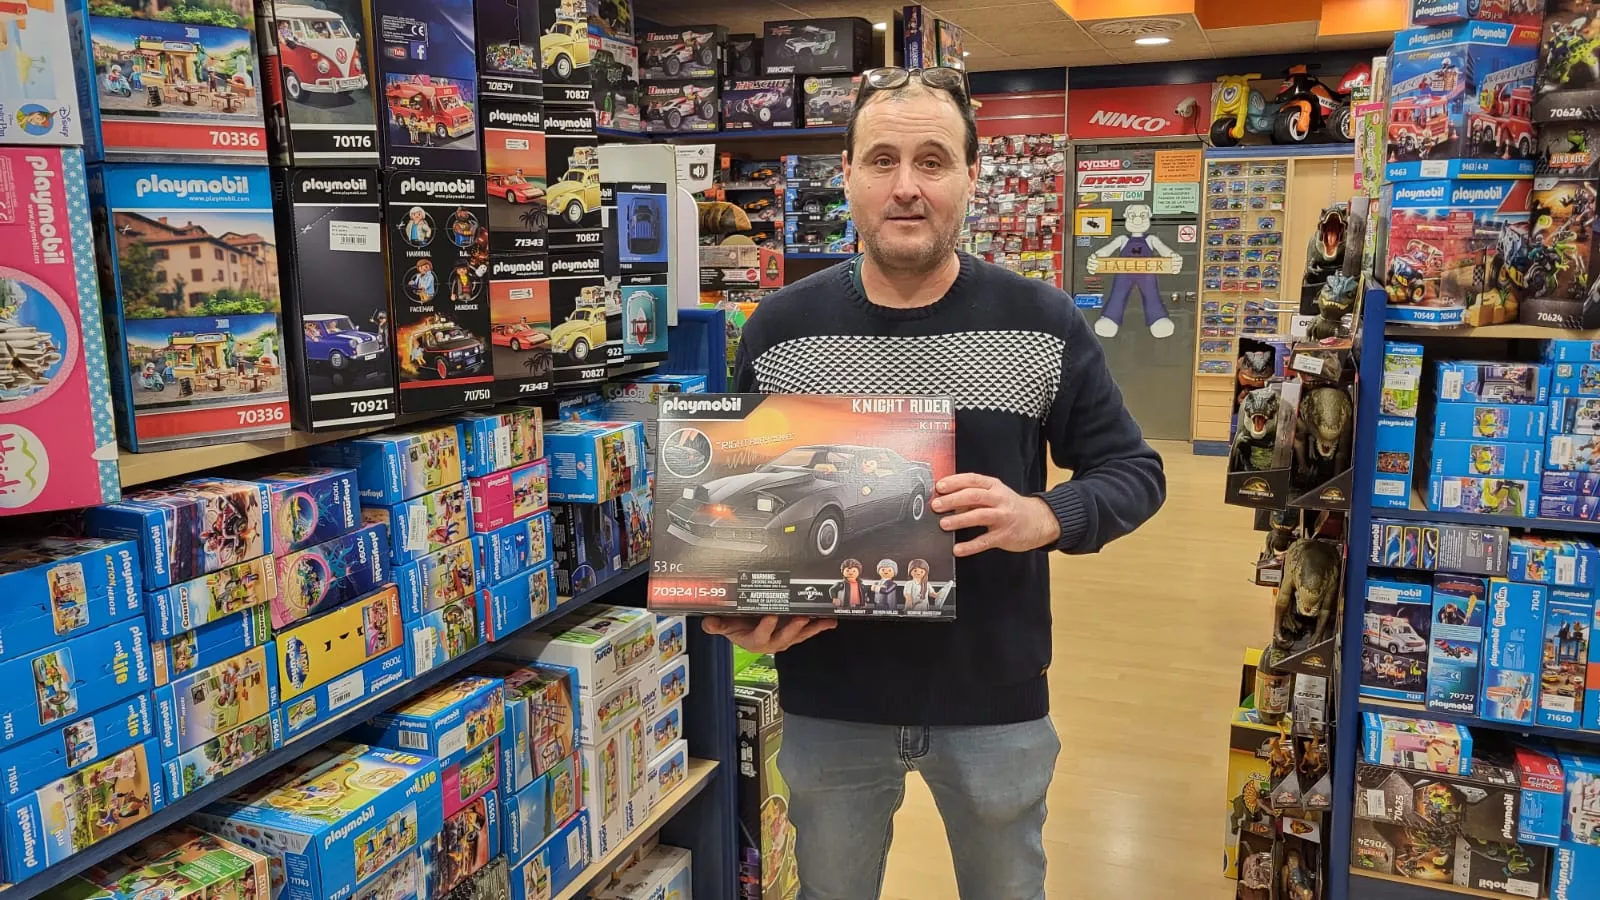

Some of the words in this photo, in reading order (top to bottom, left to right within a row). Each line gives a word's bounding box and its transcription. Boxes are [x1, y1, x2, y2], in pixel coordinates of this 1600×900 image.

[1415, 2, 1459, 18] playmobil
[1408, 29, 1454, 46] playmobil
[1472, 27, 1507, 39] playmobil
[564, 90, 590, 100] 70827
[489, 109, 540, 123] playmobil
[1089, 110, 1166, 132] NINCO
[1550, 109, 1582, 117] 70626
[543, 117, 593, 131] playmobil
[208, 130, 260, 147] 70336
[333, 135, 372, 148] 70176
[390, 155, 421, 166] 70075
[1078, 160, 1121, 170] KYOSHO
[1462, 163, 1476, 171] 9463
[1551, 155, 1569, 164] DINO
[1569, 154, 1585, 163] RISE
[1389, 169, 1407, 177] 9463
[135, 174, 249, 198] playmobil
[302, 178, 367, 193] playmobil
[400, 177, 475, 195] playmobil
[1395, 186, 1445, 201] playmobil
[1126, 191, 1143, 199] GOM
[1452, 186, 1503, 203] playmobil
[25, 155, 66, 265] playmobil
[514, 238, 544, 247] 71343
[575, 233, 600, 243] 70827
[493, 260, 544, 275] playmobil
[551, 258, 600, 272] playmobil
[1103, 260, 1164, 272] TALLER
[409, 305, 434, 313] FACEMAN
[454, 303, 479, 311] MURDOCK
[1413, 312, 1435, 320] 70549
[1537, 312, 1563, 322] 70624
[606, 346, 623, 356] 922
[580, 368, 605, 380] 70827
[464, 389, 491, 402] 70750
[519, 381, 549, 393] 71343
[350, 400, 389, 414] 70921
[662, 397, 742, 414] playmobil
[852, 398, 905, 414] KNIGHT
[909, 398, 951, 414] RIDER
[236, 407, 284, 425] 70336
[1377, 419, 1414, 427] playmobil
[1551, 400, 1561, 430] playmobil
[389, 454, 399, 493] playmobil
[487, 474, 509, 488] playmobil
[261, 489, 269, 514] 70554
[341, 478, 354, 527] playmobil
[151, 524, 165, 575] playmobil
[1369, 523, 1382, 563] playmobil
[368, 531, 383, 582] playmobil
[491, 534, 501, 580] playmobil
[105, 554, 117, 587] ACTION
[654, 560, 668, 573] 53
[669, 563, 684, 573] PC
[1580, 555, 1588, 584] playmobil
[118, 549, 138, 610] playmobil
[409, 568, 420, 614] playmobil
[652, 587, 693, 597] 70924
[698, 587, 727, 597] 5-99
[1398, 589, 1422, 598] mobil
[1553, 590, 1590, 599] playmobil
[106, 586, 116, 616] HEROES
[179, 586, 189, 629] Country
[1532, 589, 1541, 611] 71043
[157, 594, 169, 636] playmobil
[258, 603, 267, 641] Country
[494, 596, 503, 631] playmobil
[128, 625, 148, 683] playmobil
[1490, 628, 1500, 667] playmobil
[113, 640, 129, 685] myLife
[286, 636, 303, 691] playmobil
[381, 655, 401, 670] 70092
[370, 668, 403, 693] playmobil
[1450, 692, 1475, 701] 70727
[1429, 699, 1474, 712] playmobil
[127, 704, 140, 737] myLife
[137, 694, 151, 735] playmobil
[435, 709, 460, 729] playmobil
[1546, 713, 1572, 723] 71650
[2, 713, 14, 740] 71476
[160, 701, 174, 748] playmobil
[399, 720, 427, 729] playmobil
[1370, 730, 1378, 761] playmobil
[371, 749, 422, 766] myLife
[7, 765, 19, 795] 71806
[168, 763, 179, 799] playmobil
[405, 769, 437, 799] myLife
[1527, 776, 1555, 786] CITY
[152, 782, 162, 806] 71451
[487, 798, 496, 825] 70551
[1394, 795, 1404, 821] 70625
[1503, 793, 1514, 839] playmobil
[324, 804, 376, 850] playmobil
[510, 811, 519, 854] playmobil
[17, 806, 38, 868] playmobil
[579, 815, 589, 867] playmobil
[1357, 838, 1387, 848] 70624
[1556, 848, 1570, 900] playmobil
[290, 878, 310, 888] 71743
[1479, 878, 1508, 889] mobil
[328, 884, 351, 900] 71743
